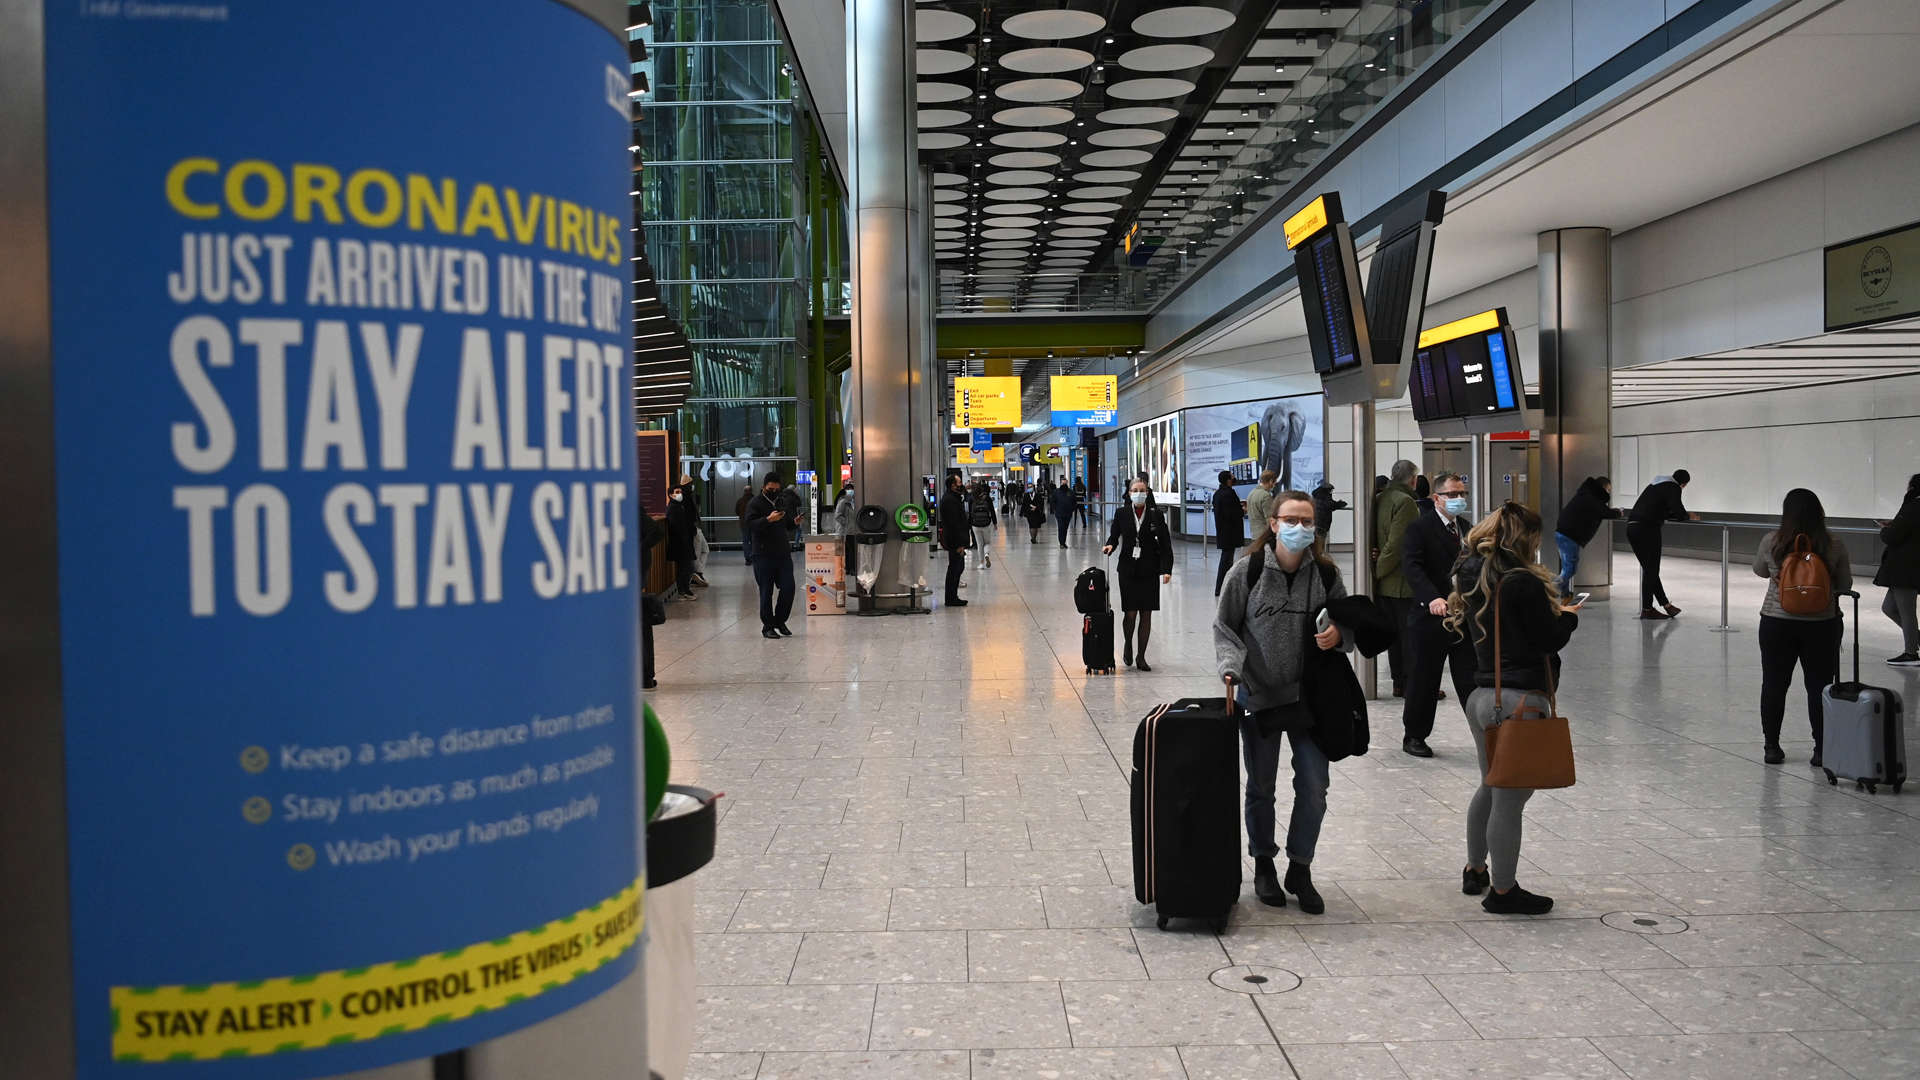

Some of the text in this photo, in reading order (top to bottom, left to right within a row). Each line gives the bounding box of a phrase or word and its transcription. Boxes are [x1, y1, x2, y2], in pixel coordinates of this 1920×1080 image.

[165, 157, 622, 267] CORONAVIRUS
[168, 233, 623, 335] JUST ARRIVED IN THE UK?
[1862, 266, 1890, 278] SKYTRAX
[170, 315, 624, 473] STAY ALERT
[1250, 430, 1257, 444] A
[173, 480, 628, 617] TO STAY SAFE
[280, 704, 614, 772] Keep a safe distance from others
[282, 745, 614, 823] Stay indoors as much as possible
[325, 792, 600, 867] Wash your hands regularly
[135, 1009, 211, 1039] STAY
[217, 999, 315, 1036] ALERT
[341, 971, 475, 1020] CONTROL
[480, 956, 524, 991] THE
[527, 939, 583, 978] VIRUS
[594, 910, 627, 949] SAVE
